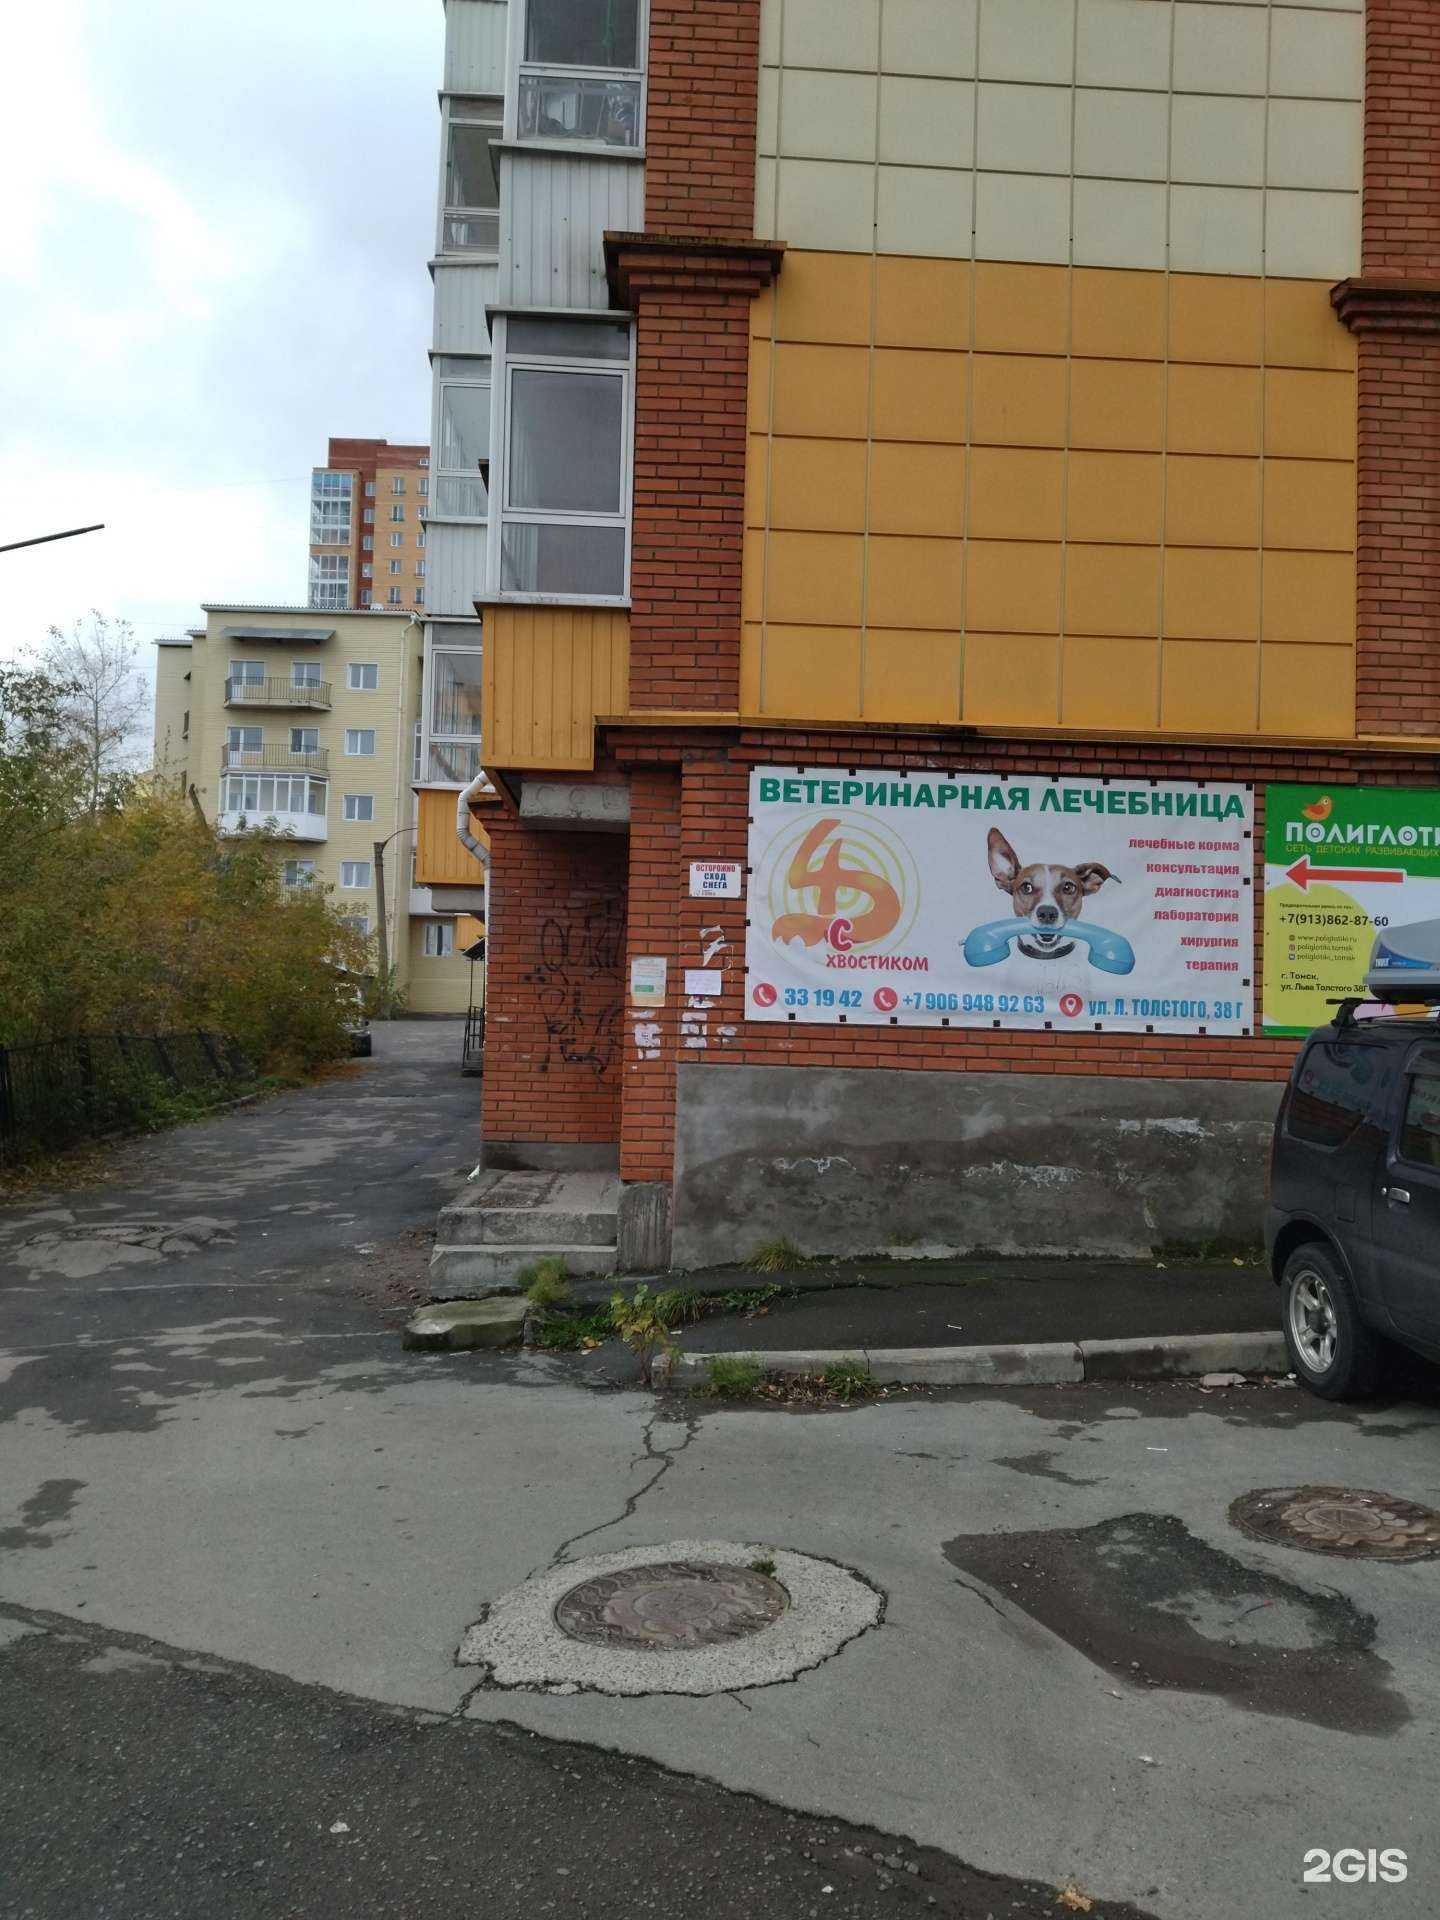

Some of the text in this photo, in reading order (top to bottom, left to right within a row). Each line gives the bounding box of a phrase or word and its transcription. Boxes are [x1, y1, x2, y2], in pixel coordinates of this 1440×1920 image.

[759, 777, 1245, 822] ВЕТЕРИНАРНАЯ ЛЕЧЕБНИЦА
[1128, 838, 1240, 852] лечебные корма
[1316, 844, 1361, 855] ДЕТСКИХ
[695, 863, 736, 872] ОСТОРОЖНО
[1146, 863, 1240, 876] консультация
[704, 872, 727, 881] СХОД
[702, 881, 728, 889] СНЕГА
[1154, 887, 1240, 899] диагностика
[1153, 910, 1239, 923] лаборатория
[1279, 913, 1389, 927] +7(913)862-87-60
[829, 918, 853, 951] С
[1180, 936, 1239, 948] хирургия
[826, 953, 929, 972] ХВОСТИКОМ
[1185, 960, 1239, 972] терапия
[1290, 971, 1319, 981] Томск,
[1280, 982, 1369, 993] ул. Льва Толстого 38Г
[784, 987, 863, 1008] 33 19 42
[903, 991, 1045, 1014] +7 906 948 92 63
[1088, 998, 1243, 1019] ул. Л. ТОЛСТОГО, 38 Г
